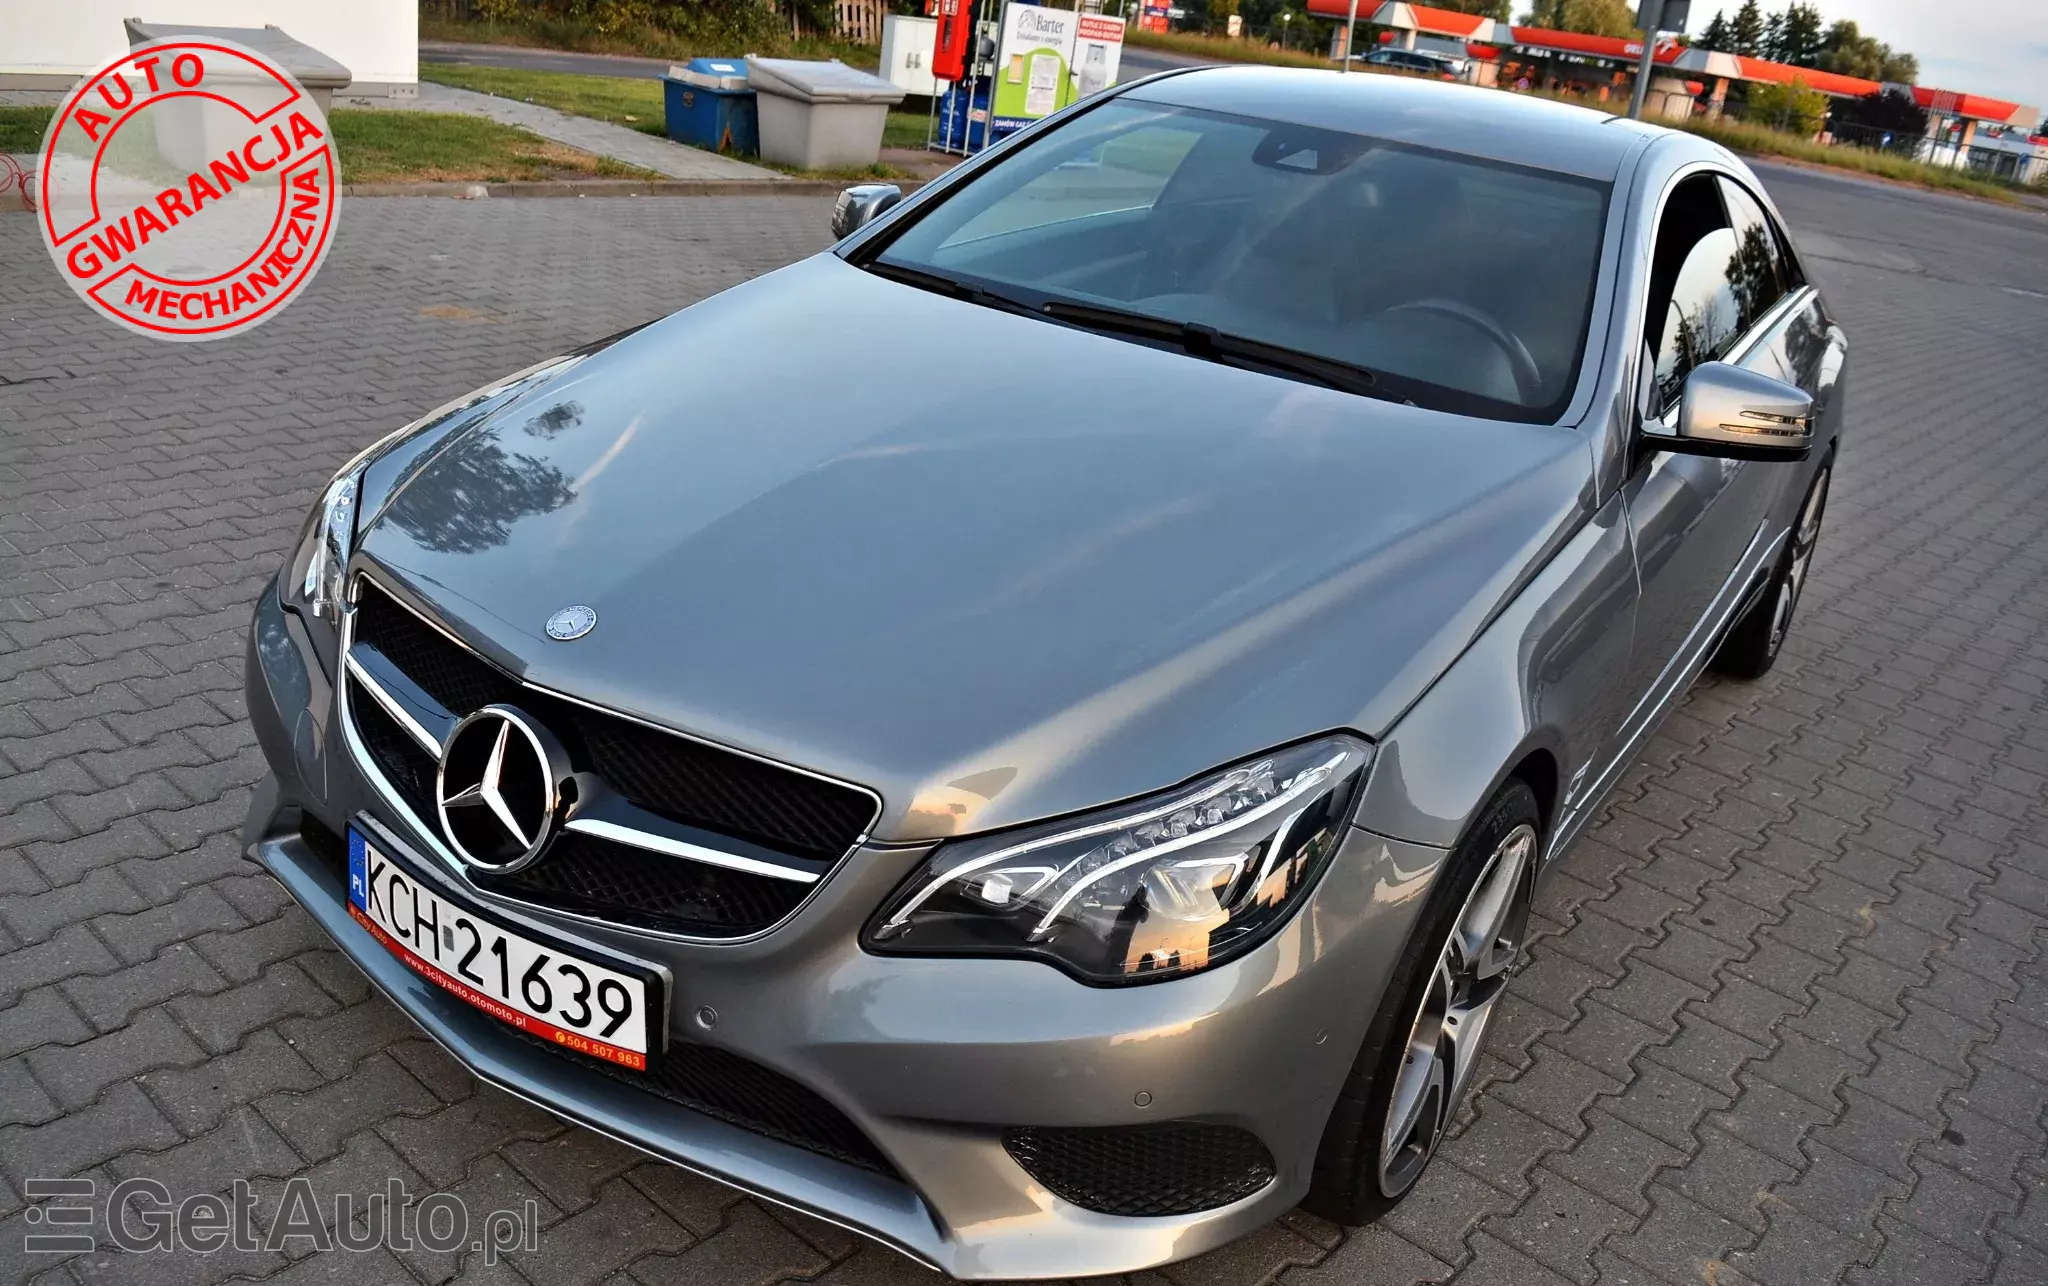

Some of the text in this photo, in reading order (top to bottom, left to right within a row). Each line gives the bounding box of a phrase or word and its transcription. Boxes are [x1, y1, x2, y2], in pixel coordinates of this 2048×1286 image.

[1036, 14, 1064, 34] Barter
[352, 873, 365, 898] PL
[367, 849, 633, 1039] KCH 21639
[404, 952, 527, 1027] www.3cityauto.otomoto.pl
[567, 1036, 641, 1067] 504 507 963
